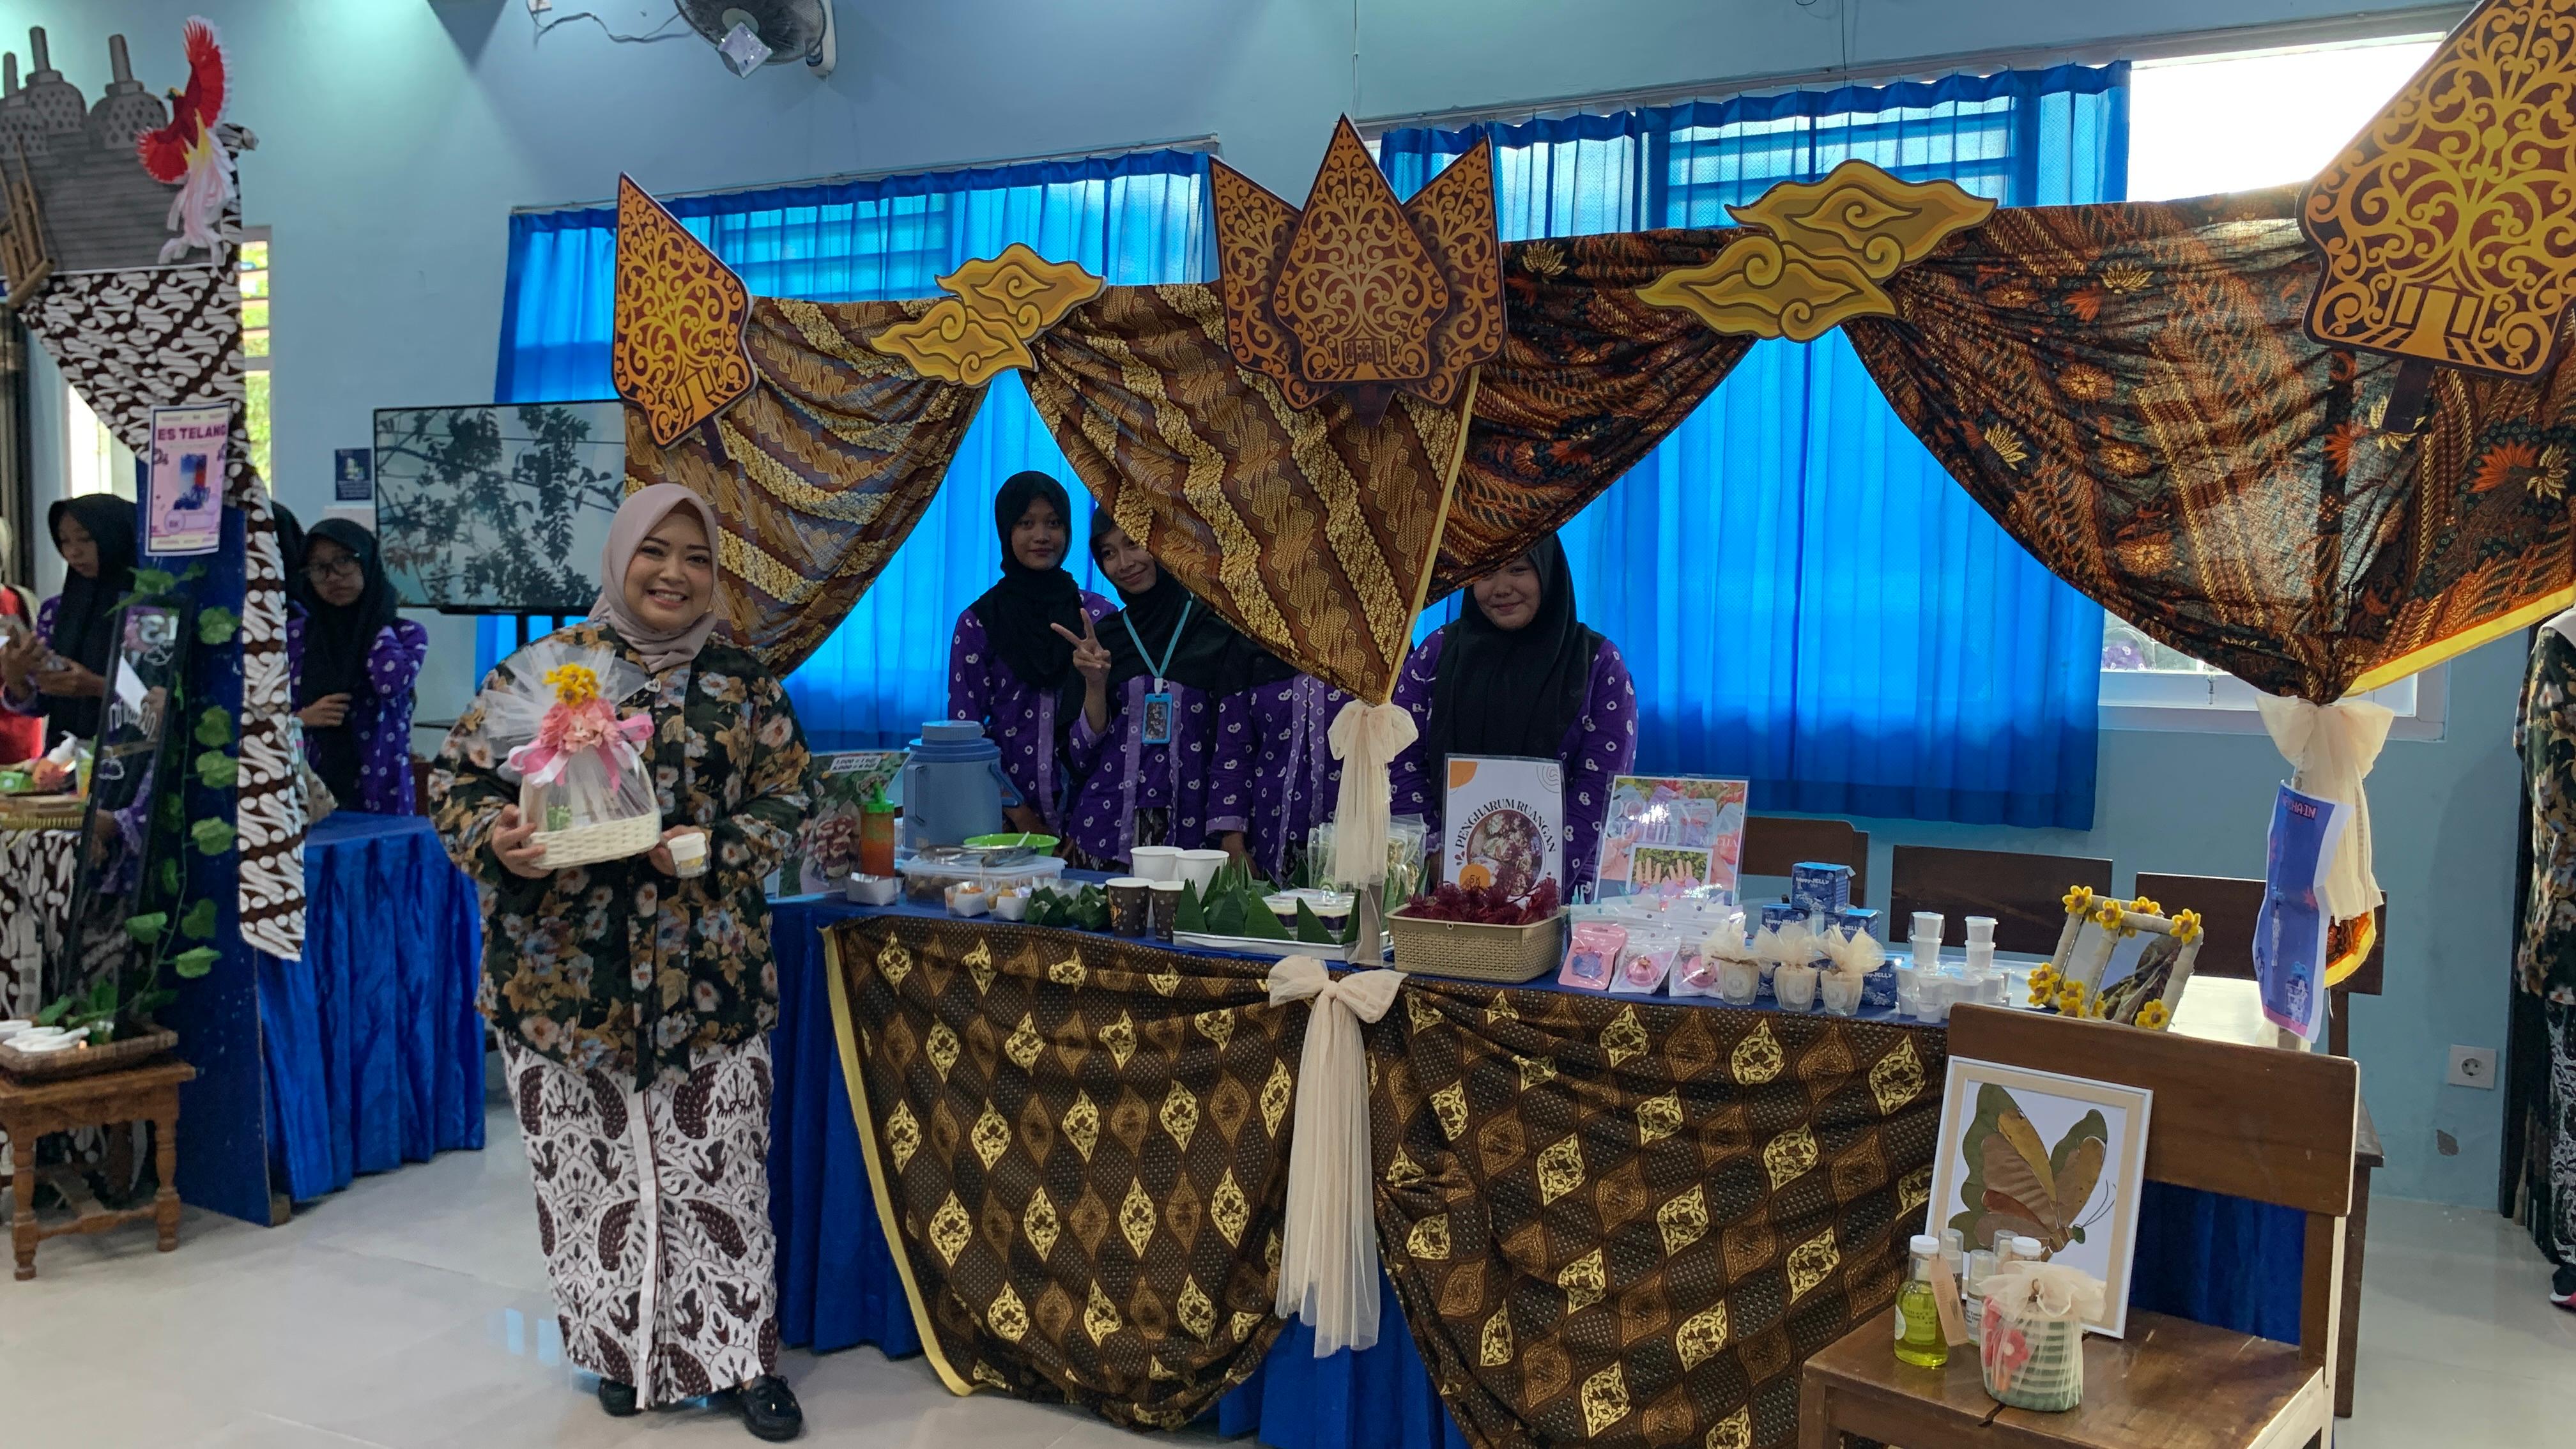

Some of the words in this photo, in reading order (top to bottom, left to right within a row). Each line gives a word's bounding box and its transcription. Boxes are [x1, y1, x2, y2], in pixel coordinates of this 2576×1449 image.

[158, 428, 176, 440] ES
[1455, 798, 1515, 848] PENGHARUM
[1517, 800, 1556, 852] RUANGAN
